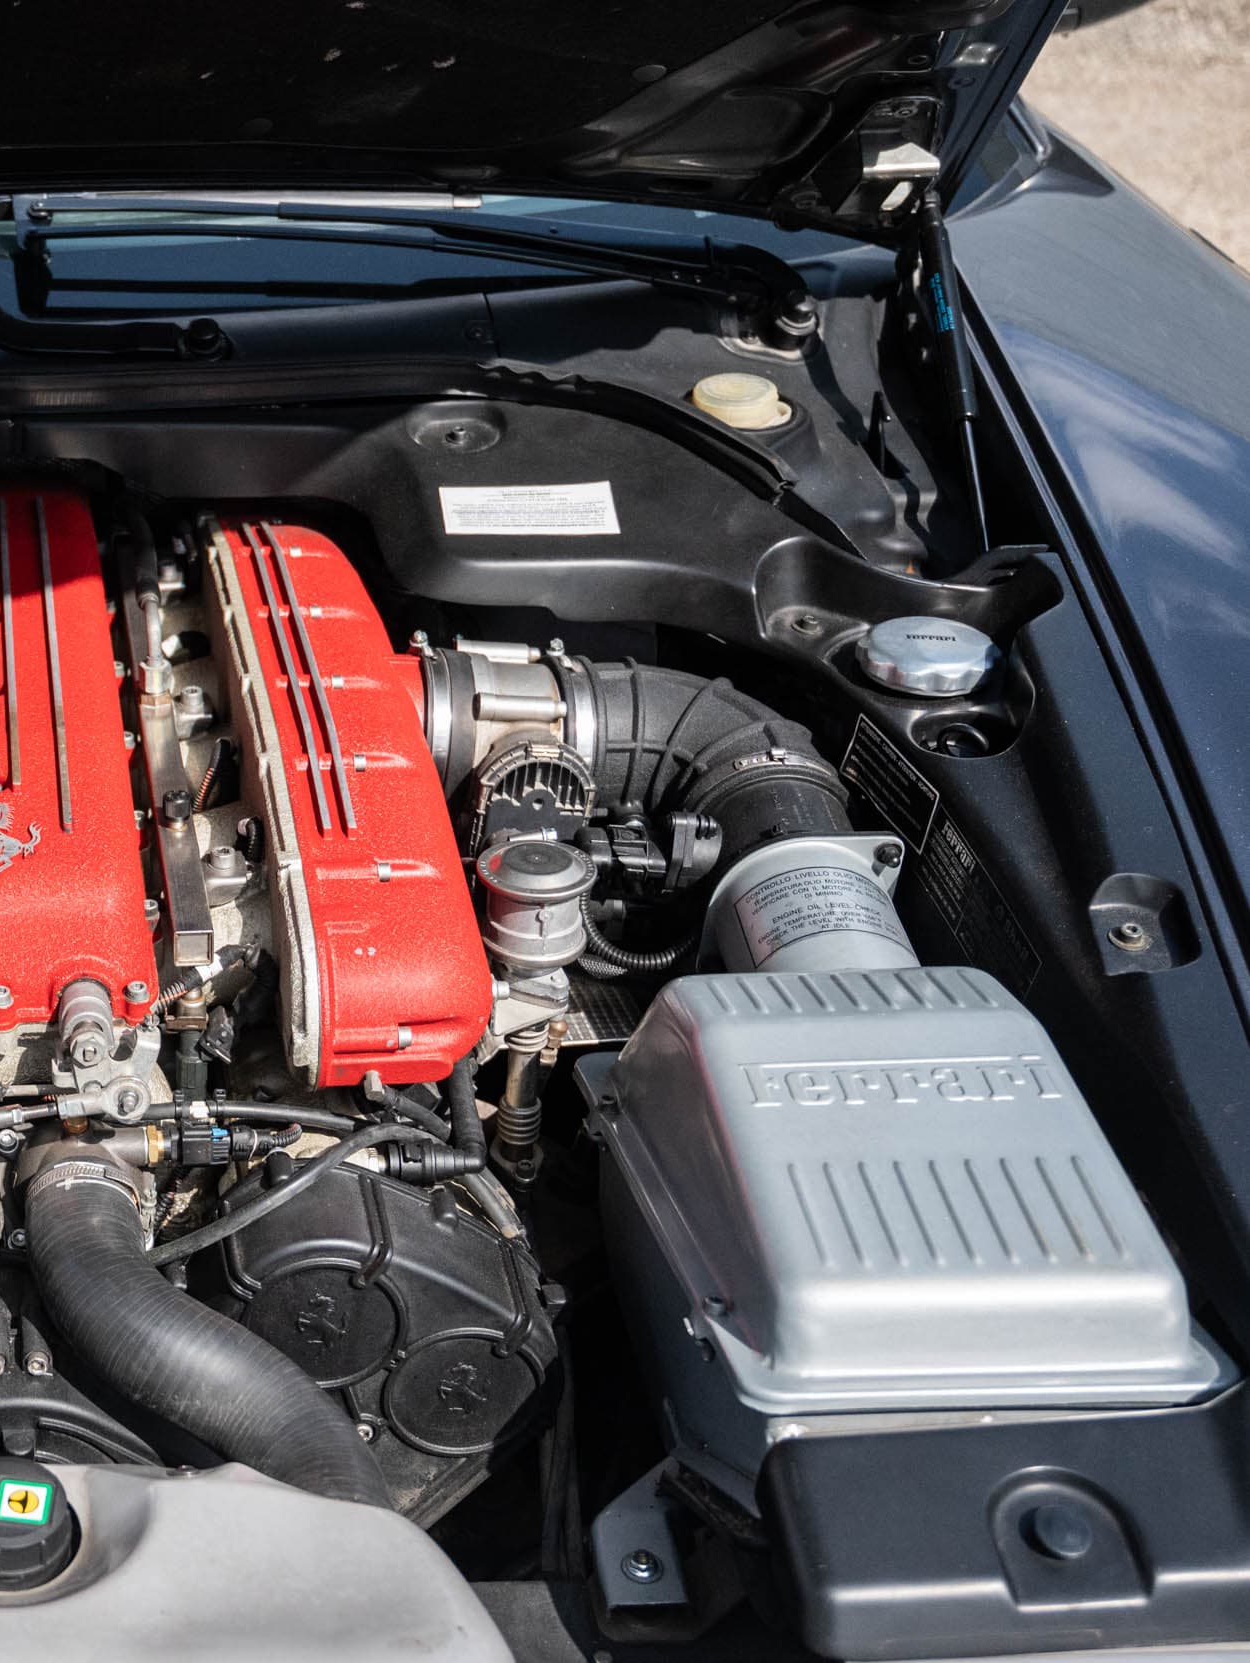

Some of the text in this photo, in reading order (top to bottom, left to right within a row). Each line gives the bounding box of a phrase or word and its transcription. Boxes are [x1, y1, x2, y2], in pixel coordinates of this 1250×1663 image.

[942, 819, 976, 874] Ferrari
[745, 876, 791, 904] CONTROLLO
[795, 871, 830, 880] LIVELLO
[833, 871, 853, 880] OLIO
[792, 887, 810, 895] CON
[758, 926, 781, 944] ENGINE
[784, 910, 835, 928] TEMPERATURE
[772, 907, 803, 925] ENGINE
[807, 903, 821, 911] OIL
[791, 922, 805, 931] THE
[809, 918, 832, 926] LEVEL
[738, 1053, 1062, 1107] Ferrari
